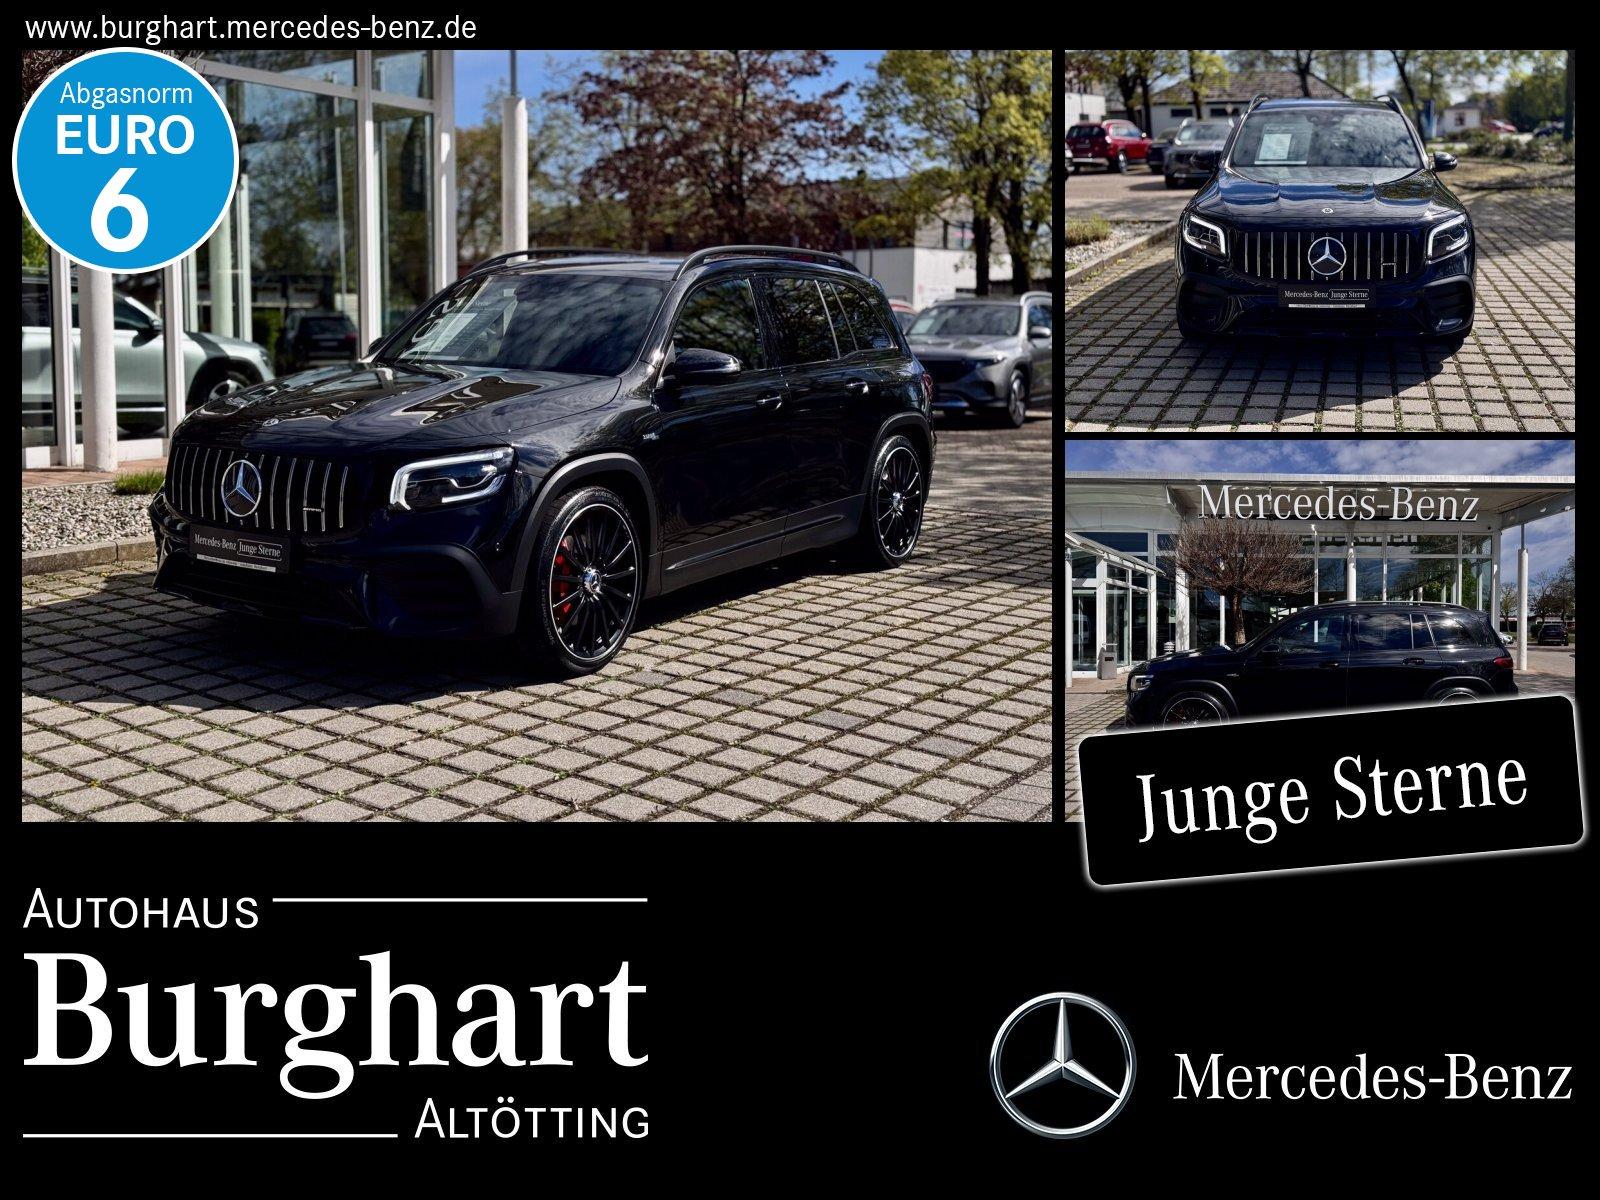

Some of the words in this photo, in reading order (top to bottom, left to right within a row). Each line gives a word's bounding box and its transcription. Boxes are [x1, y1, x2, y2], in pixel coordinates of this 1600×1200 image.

[1284, 290, 1328, 298] Mercedes-Benz
[1331, 290, 1347, 300] Junge
[1348, 290, 1368, 298] Sterne
[1197, 484, 1479, 522] Mercedes-Benz
[194, 533, 237, 551] Mercedes-Benz
[239, 541, 257, 555] Junge
[258, 544, 281, 557] Sterne
